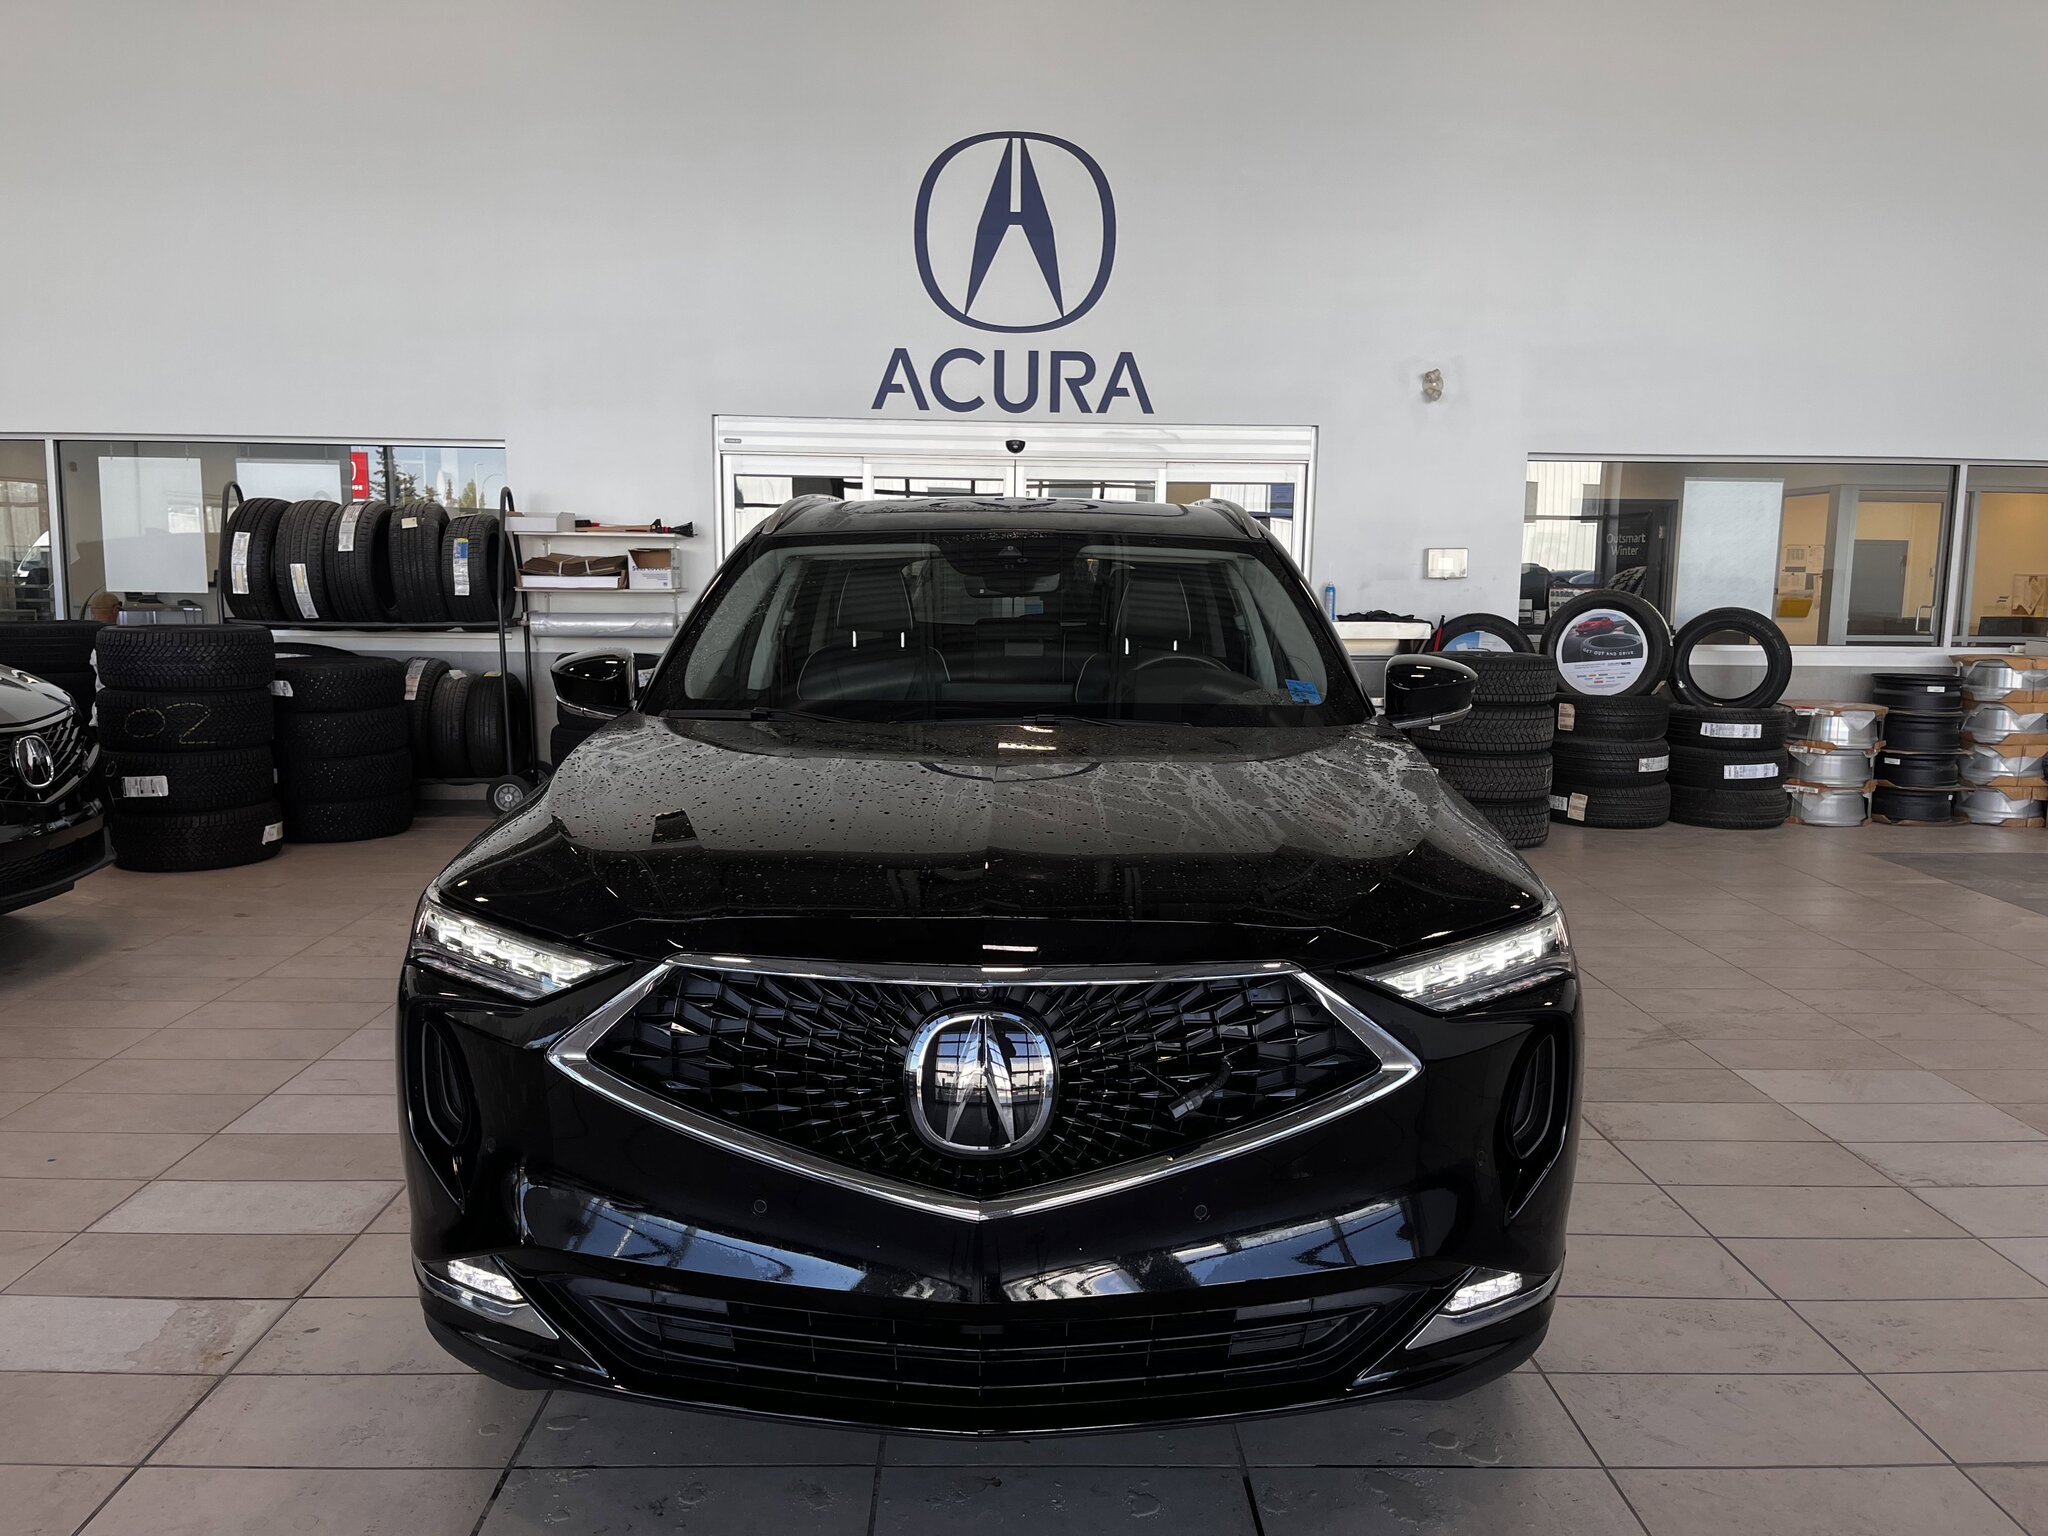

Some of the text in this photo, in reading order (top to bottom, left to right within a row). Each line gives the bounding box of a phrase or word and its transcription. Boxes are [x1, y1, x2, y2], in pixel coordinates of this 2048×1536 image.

[871, 347, 1154, 415] ACURA
[1606, 533, 1646, 544] Outsmart
[1610, 545, 1639, 556] Winter
